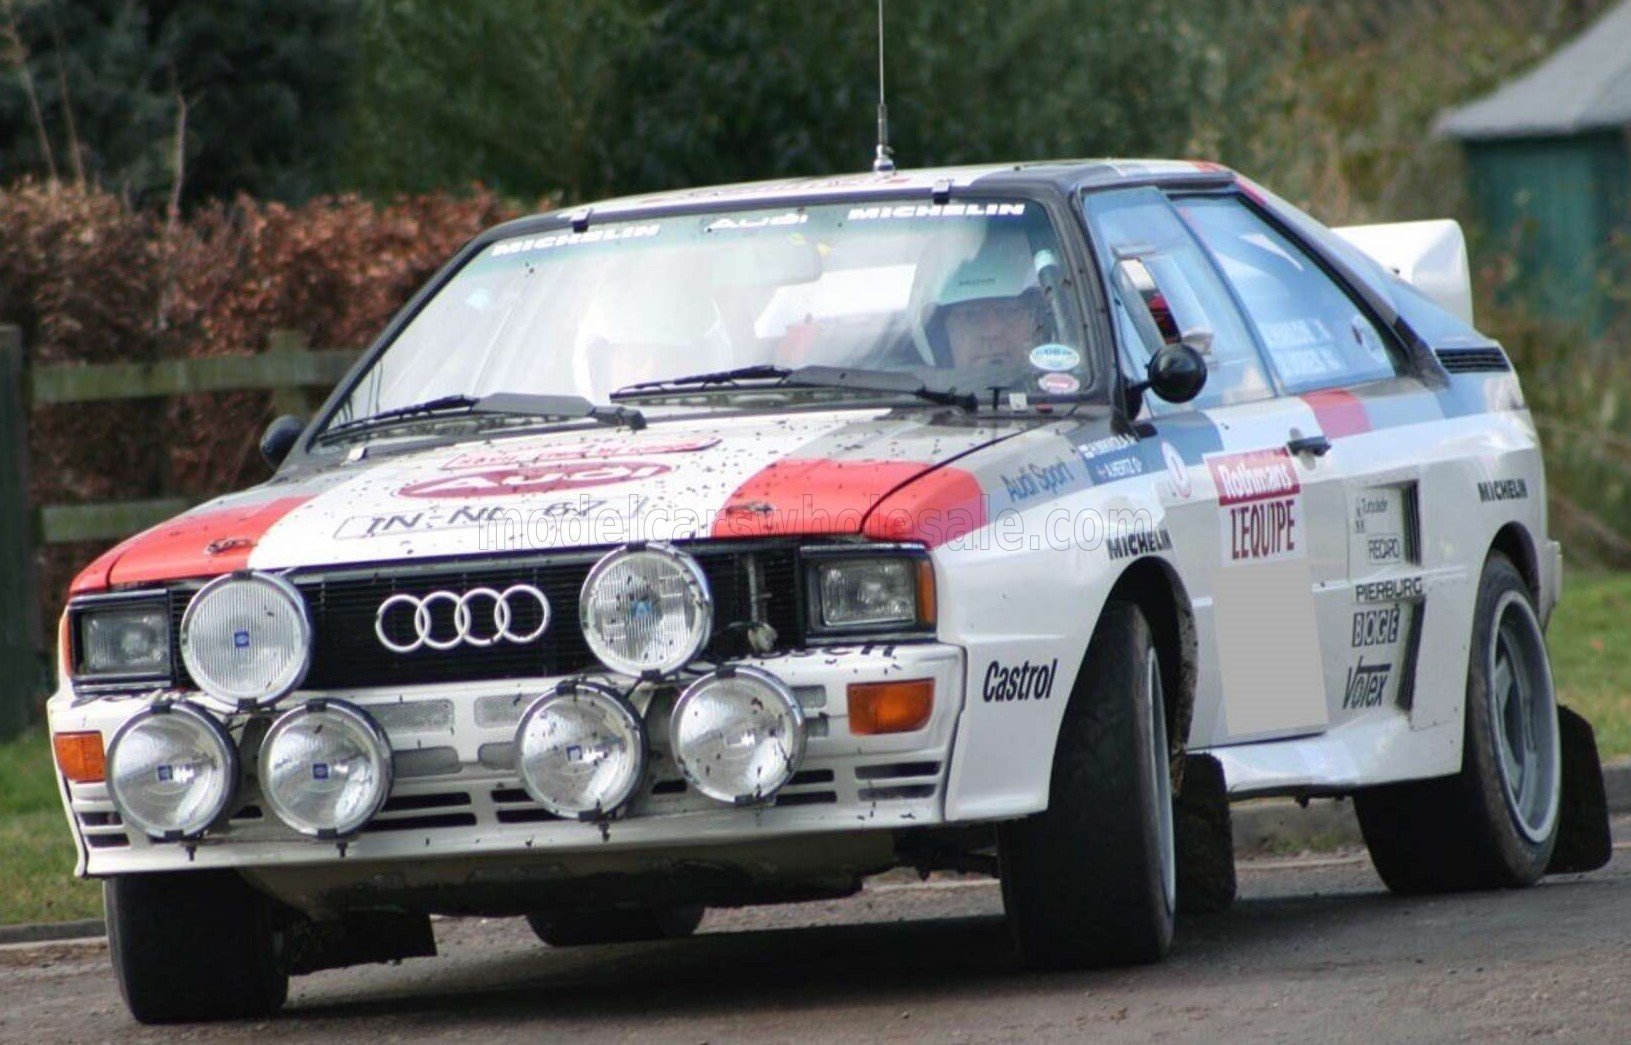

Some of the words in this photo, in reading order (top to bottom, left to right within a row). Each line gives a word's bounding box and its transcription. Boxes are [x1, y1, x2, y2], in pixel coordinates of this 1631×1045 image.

[848, 203, 1025, 219] MICHELIN
[493, 224, 660, 256] MICHELIN
[1218, 462, 1293, 499] Rothmans
[1477, 478, 1528, 502] MICHELIN
[1106, 529, 1173, 560] MICHELIN
[1355, 577, 1423, 602] PIERBURG
[983, 658, 1058, 703] Castrol
